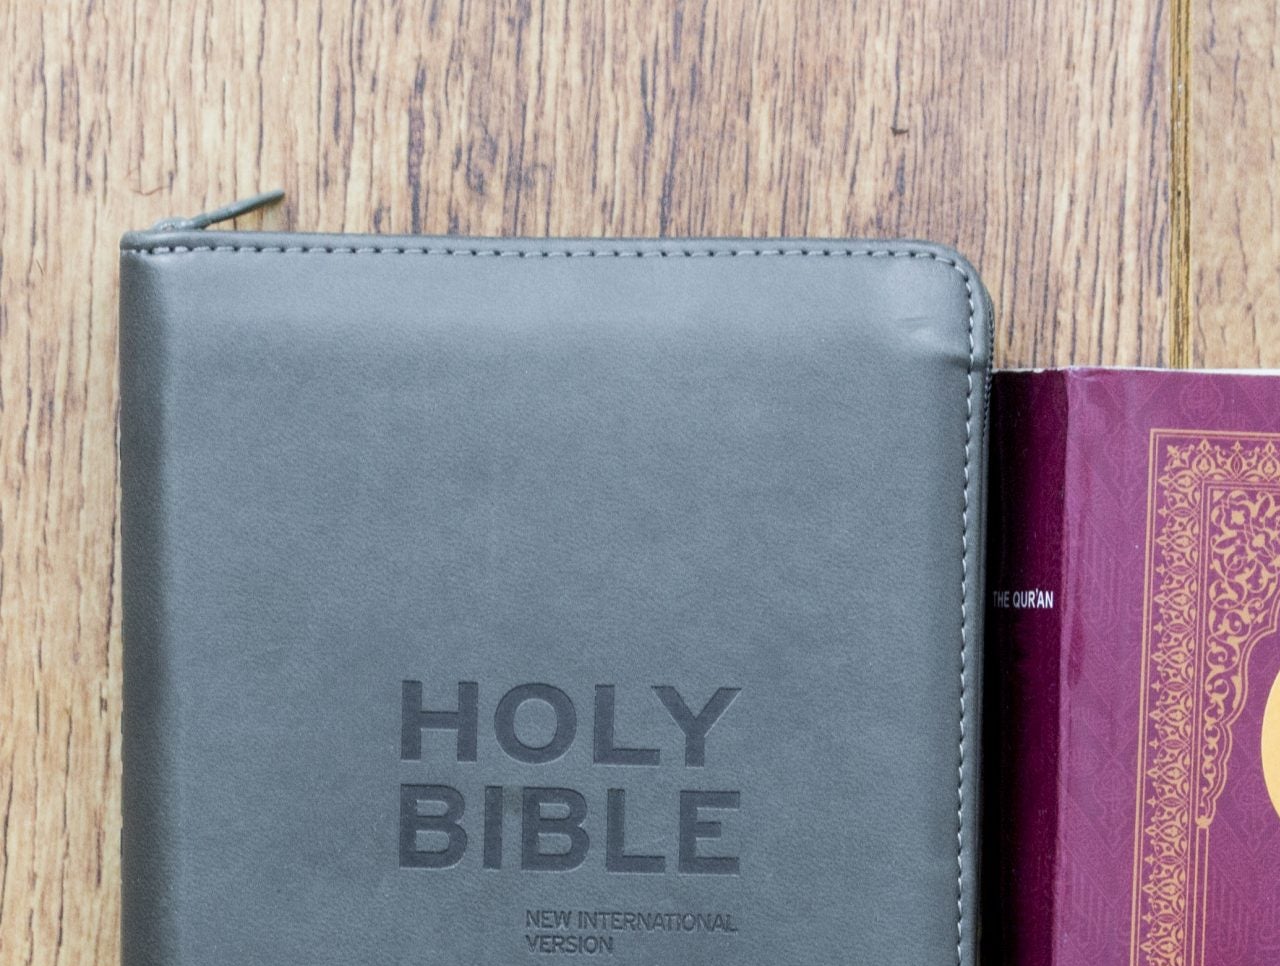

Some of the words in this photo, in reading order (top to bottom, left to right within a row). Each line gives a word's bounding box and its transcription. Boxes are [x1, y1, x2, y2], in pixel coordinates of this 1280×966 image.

[993, 590, 1010, 608] THE
[400, 680, 742, 768] HOLY
[399, 783, 741, 877] BIBLE
[525, 909, 572, 929] NEW
[577, 910, 738, 933] INTERNATIONAL
[524, 934, 614, 955] VERSION
